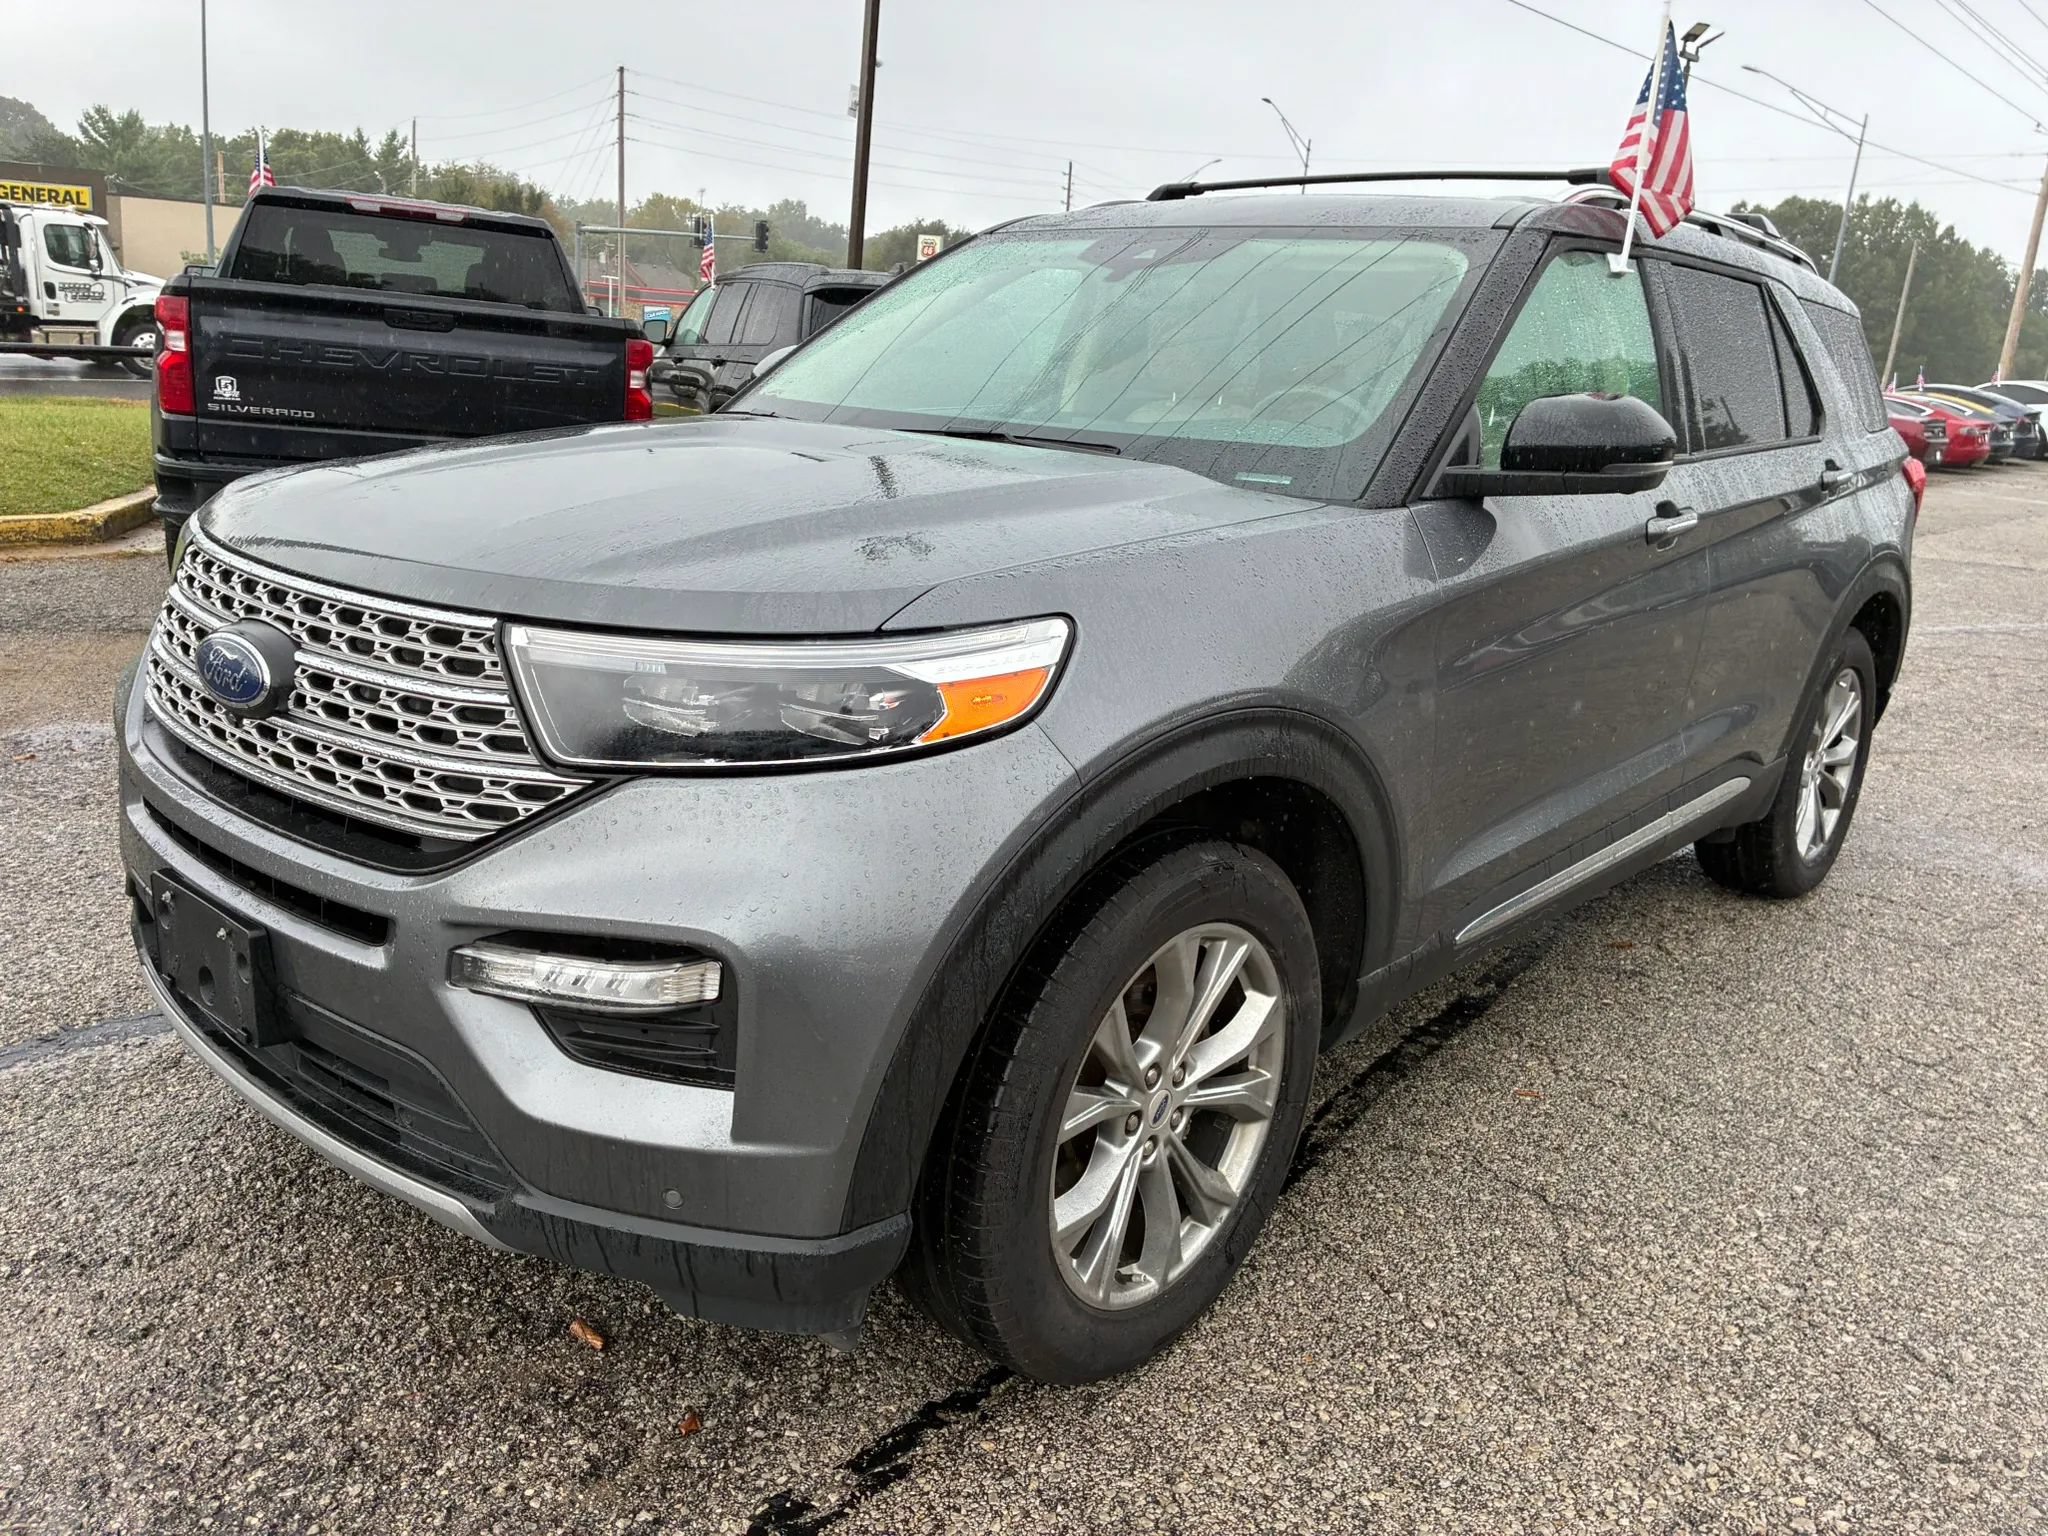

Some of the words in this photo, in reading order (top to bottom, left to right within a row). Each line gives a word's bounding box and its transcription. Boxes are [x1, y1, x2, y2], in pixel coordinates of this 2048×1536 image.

[0, 184, 87, 206] GENERAL
[923, 246, 935, 255] 66
[224, 337, 602, 386] CHEVROLET
[207, 402, 316, 419] SILVERADO
[204, 645, 248, 692] Ford
